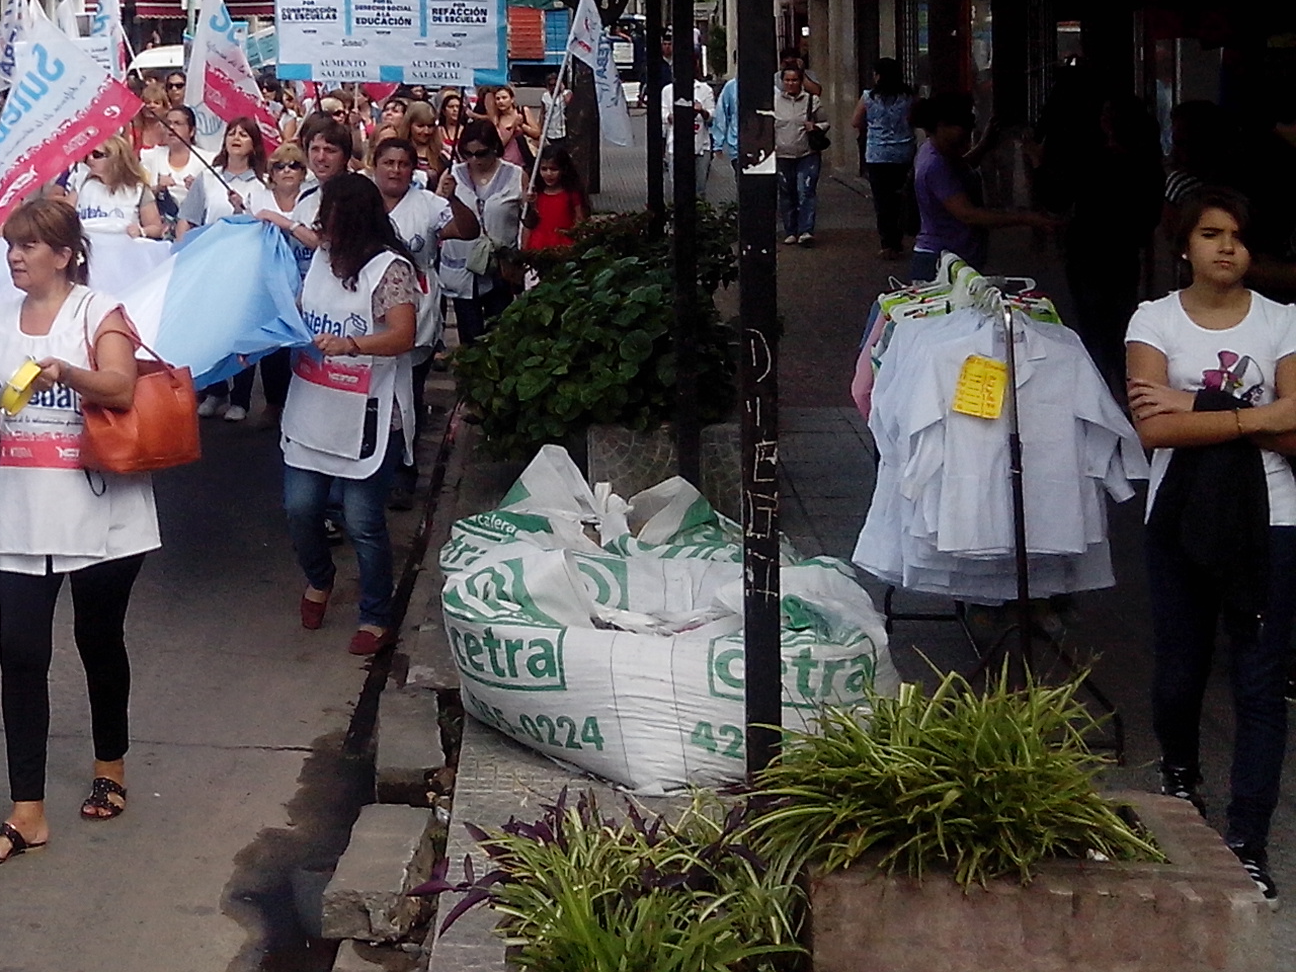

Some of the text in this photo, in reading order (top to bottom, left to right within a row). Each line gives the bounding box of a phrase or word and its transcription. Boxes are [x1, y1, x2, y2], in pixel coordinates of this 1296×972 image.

[295, 12, 337, 20] ESCUELAS
[432, 7, 488, 16] REFACCIÓN
[355, 16, 412, 26] EDUCACIÓN
[715, 646, 873, 698] ctra
